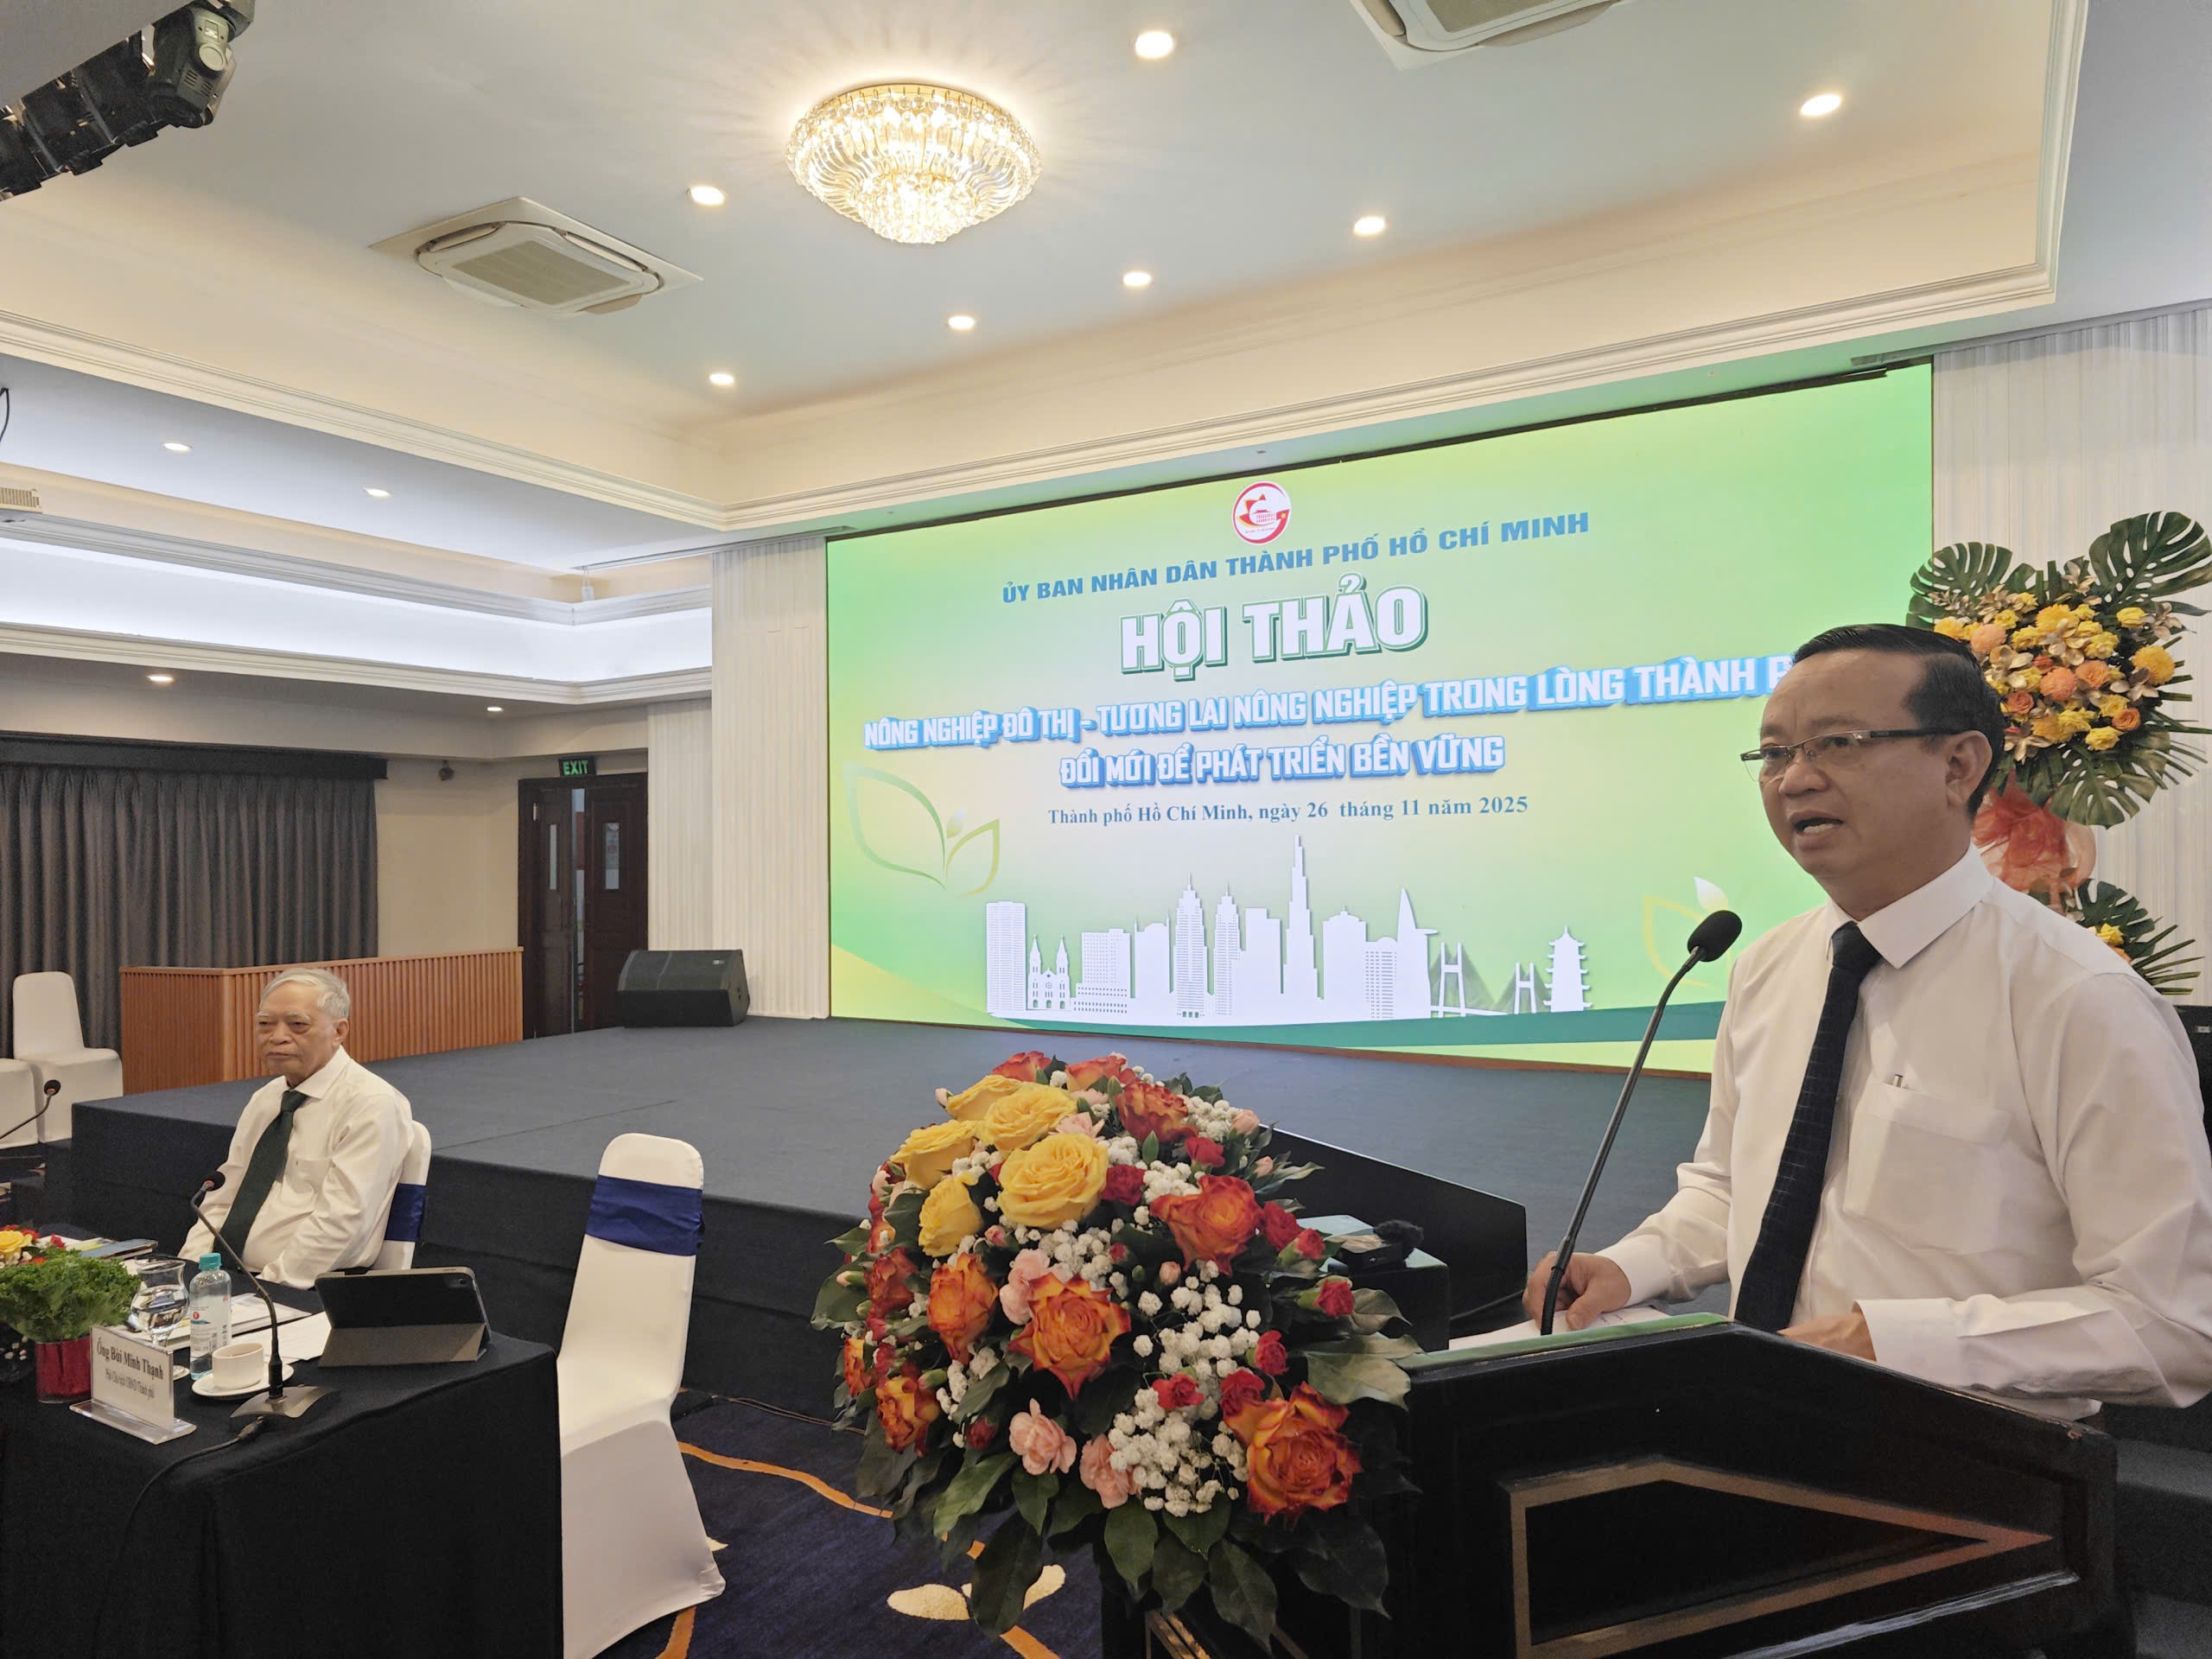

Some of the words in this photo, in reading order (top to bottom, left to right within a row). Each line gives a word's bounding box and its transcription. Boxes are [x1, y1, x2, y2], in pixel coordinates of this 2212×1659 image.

[1002, 581, 1030, 603] ỦY
[1037, 577, 1084, 600] BAN
[1091, 568, 1157, 593] NHÂN
[1166, 560, 1217, 584] DÂN
[1225, 549, 1313, 576] THÀNH
[1322, 532, 1380, 564] PHỐ
[1389, 527, 1427, 556] HỒ
[1439, 520, 1491, 550] CHÍ
[1501, 512, 1589, 543] MINH
[1120, 598, 1228, 682] HỘI
[1242, 571, 1428, 664] THẢO
[864, 717, 925, 750] NÔNG
[922, 710, 1000, 749] NGHIỆP
[1001, 706, 1039, 742] ĐÔ
[1038, 708, 1081, 743] THỊ
[1096, 700, 1185, 737] TƯƠNG
[1188, 696, 1229, 731] LAI
[1234, 689, 1307, 729] NÔNG
[1312, 679, 1418, 726] NGHIỆP
[1421, 675, 1527, 718] TRONG
[1529, 665, 1625, 711] LÒNG
[1626, 655, 1758, 705] THÀNH
[563, 760, 588, 775] EXIT
[1059, 747, 1105, 788] ĐỔI
[1106, 749, 1155, 786] MỚI
[1157, 742, 1193, 784] ĐỂ
[1196, 743, 1263, 783] PHÁT
[1267, 735, 1345, 781] TRIỂN
[1350, 733, 1411, 778] BỀN
[1412, 733, 1505, 776] VỮNG
[1048, 809, 1098, 823] Thành
[1103, 804, 1132, 826] phố
[1138, 803, 1161, 822] Hồ
[1166, 804, 1197, 821] Chí
[1202, 804, 1253, 821] Minh,
[1258, 804, 1301, 823] ngày
[1306, 801, 1328, 818] 26
[1339, 801, 1394, 820] tháng
[1401, 799, 1420, 816] 11
[1428, 798, 1471, 815] năm
[1478, 796, 1529, 814] 2025
[124, 1351, 141, 1370] Minh
